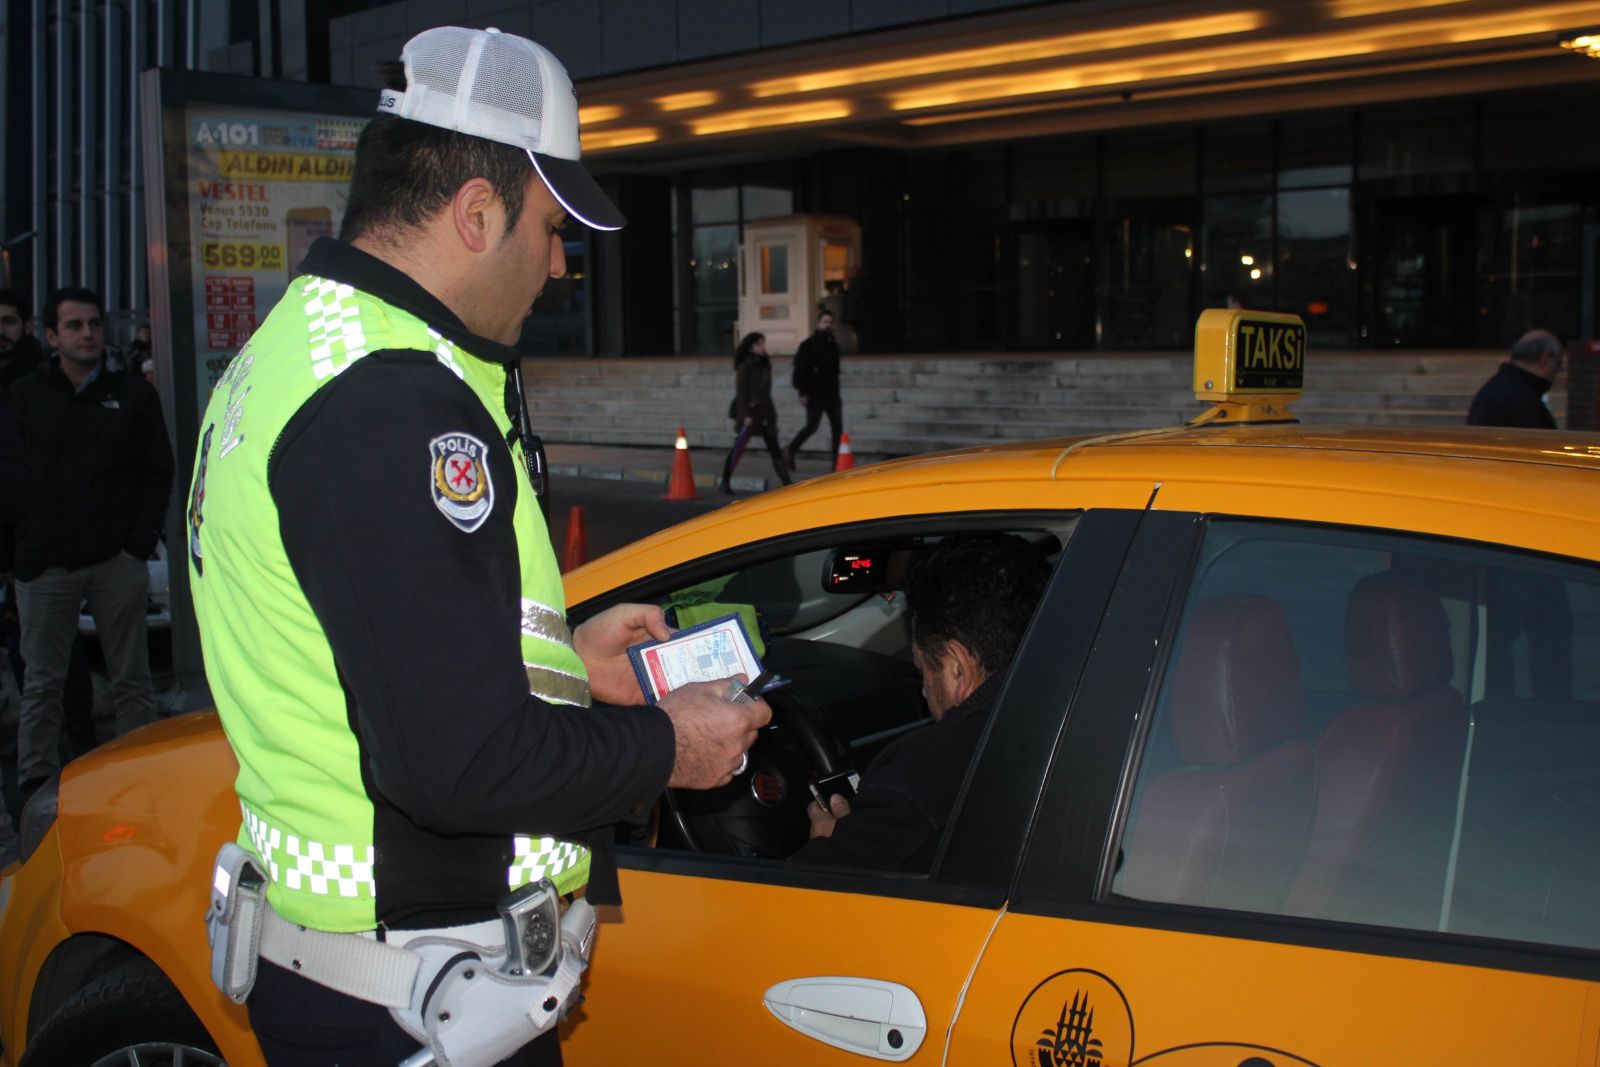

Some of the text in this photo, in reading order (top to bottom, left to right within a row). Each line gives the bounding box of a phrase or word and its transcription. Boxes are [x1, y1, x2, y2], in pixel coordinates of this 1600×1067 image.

[226, 155, 294, 175] ALDIN
[198, 181, 271, 202] VESTEL
[200, 203, 235, 217] Venus
[227, 218, 277, 232] Telefonu
